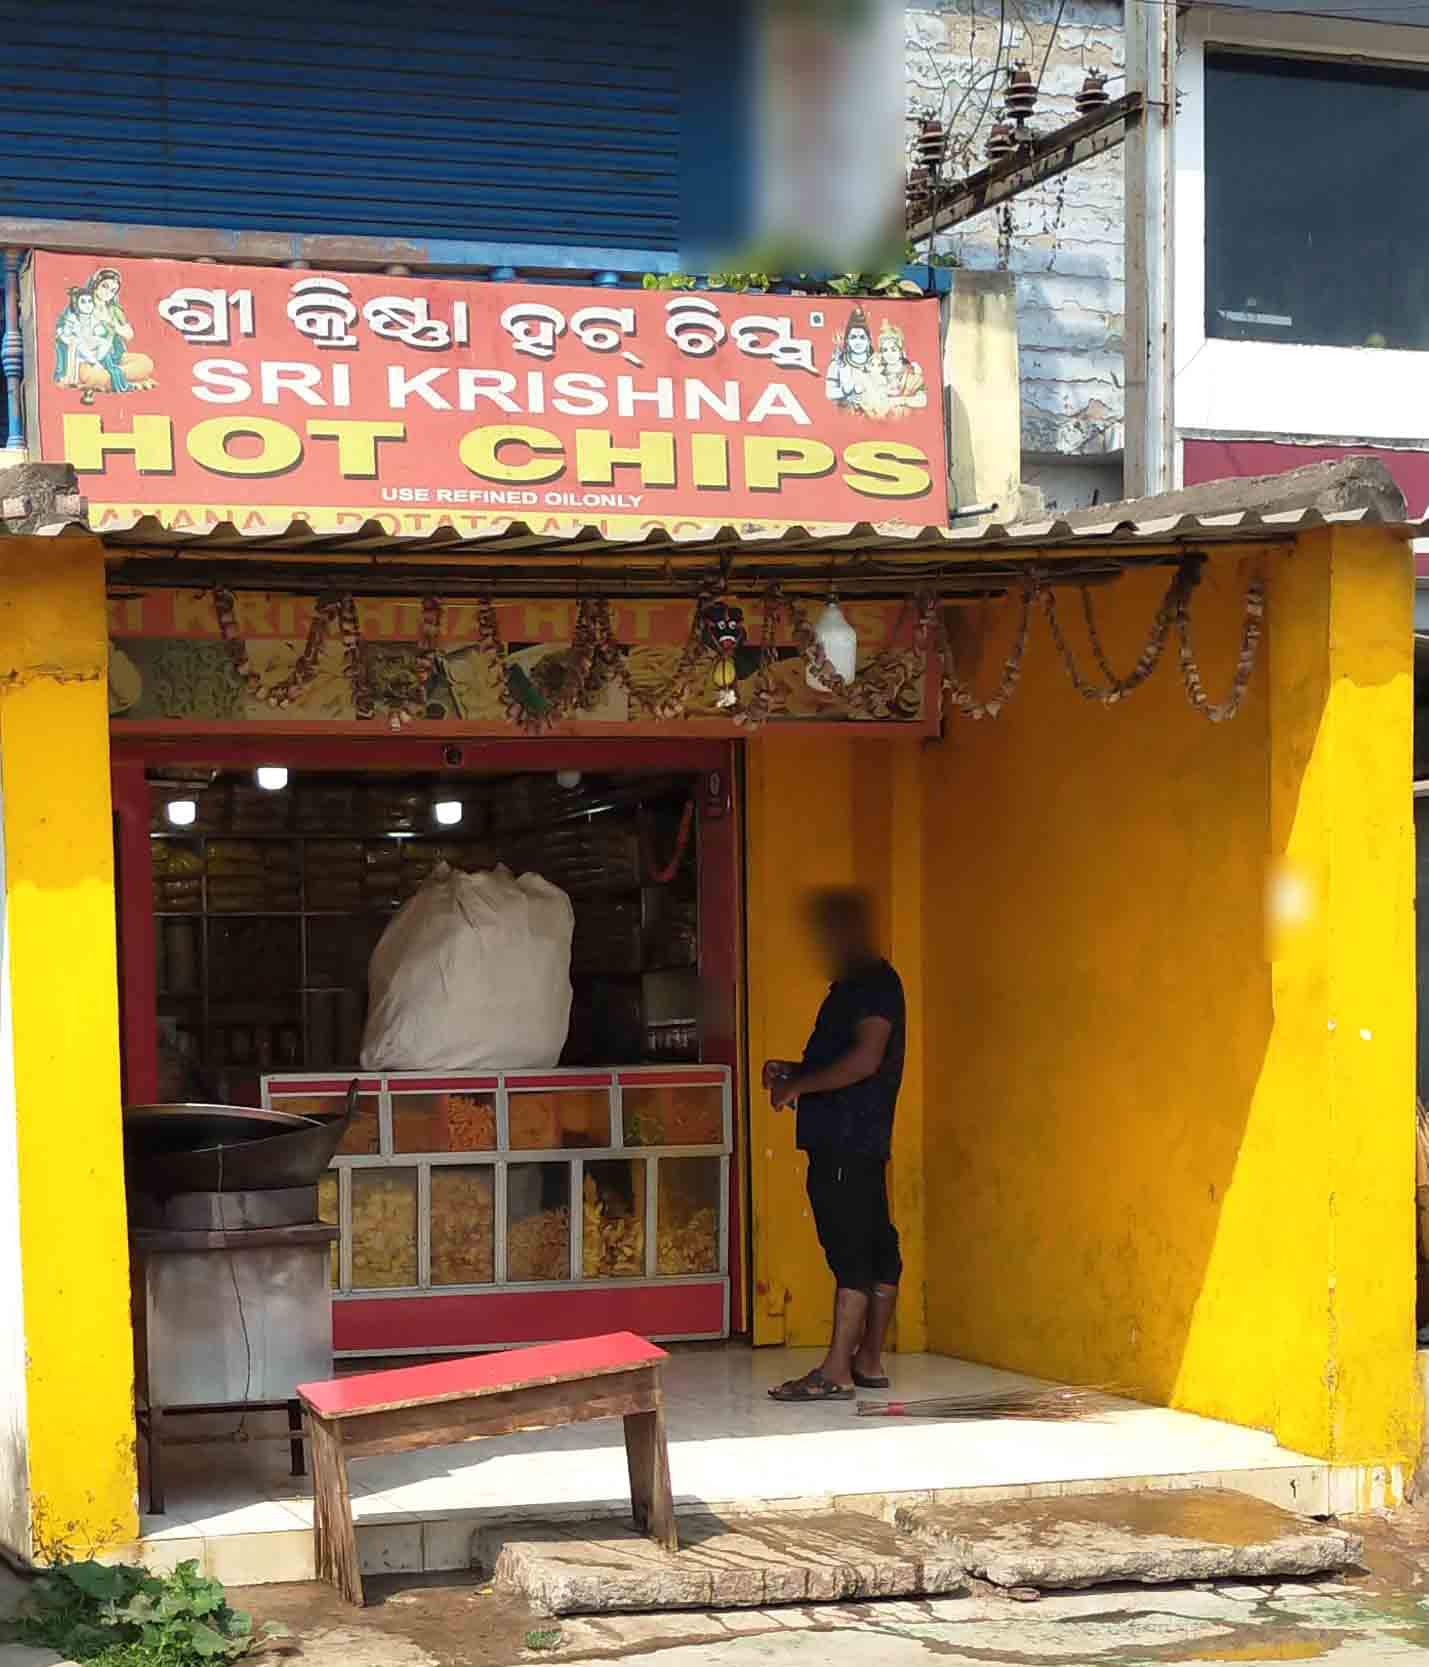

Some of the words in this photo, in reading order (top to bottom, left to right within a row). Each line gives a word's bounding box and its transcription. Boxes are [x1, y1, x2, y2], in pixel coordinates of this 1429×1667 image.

[159, 287, 255, 344] ଶ୍ରୀ
[191, 358, 350, 407] SRI
[387, 365, 813, 425] KRISHNA
[62, 413, 406, 479] HOT
[459, 424, 933, 500] CHIPS
[381, 488, 430, 501] USE
[436, 489, 538, 505] REFINED
